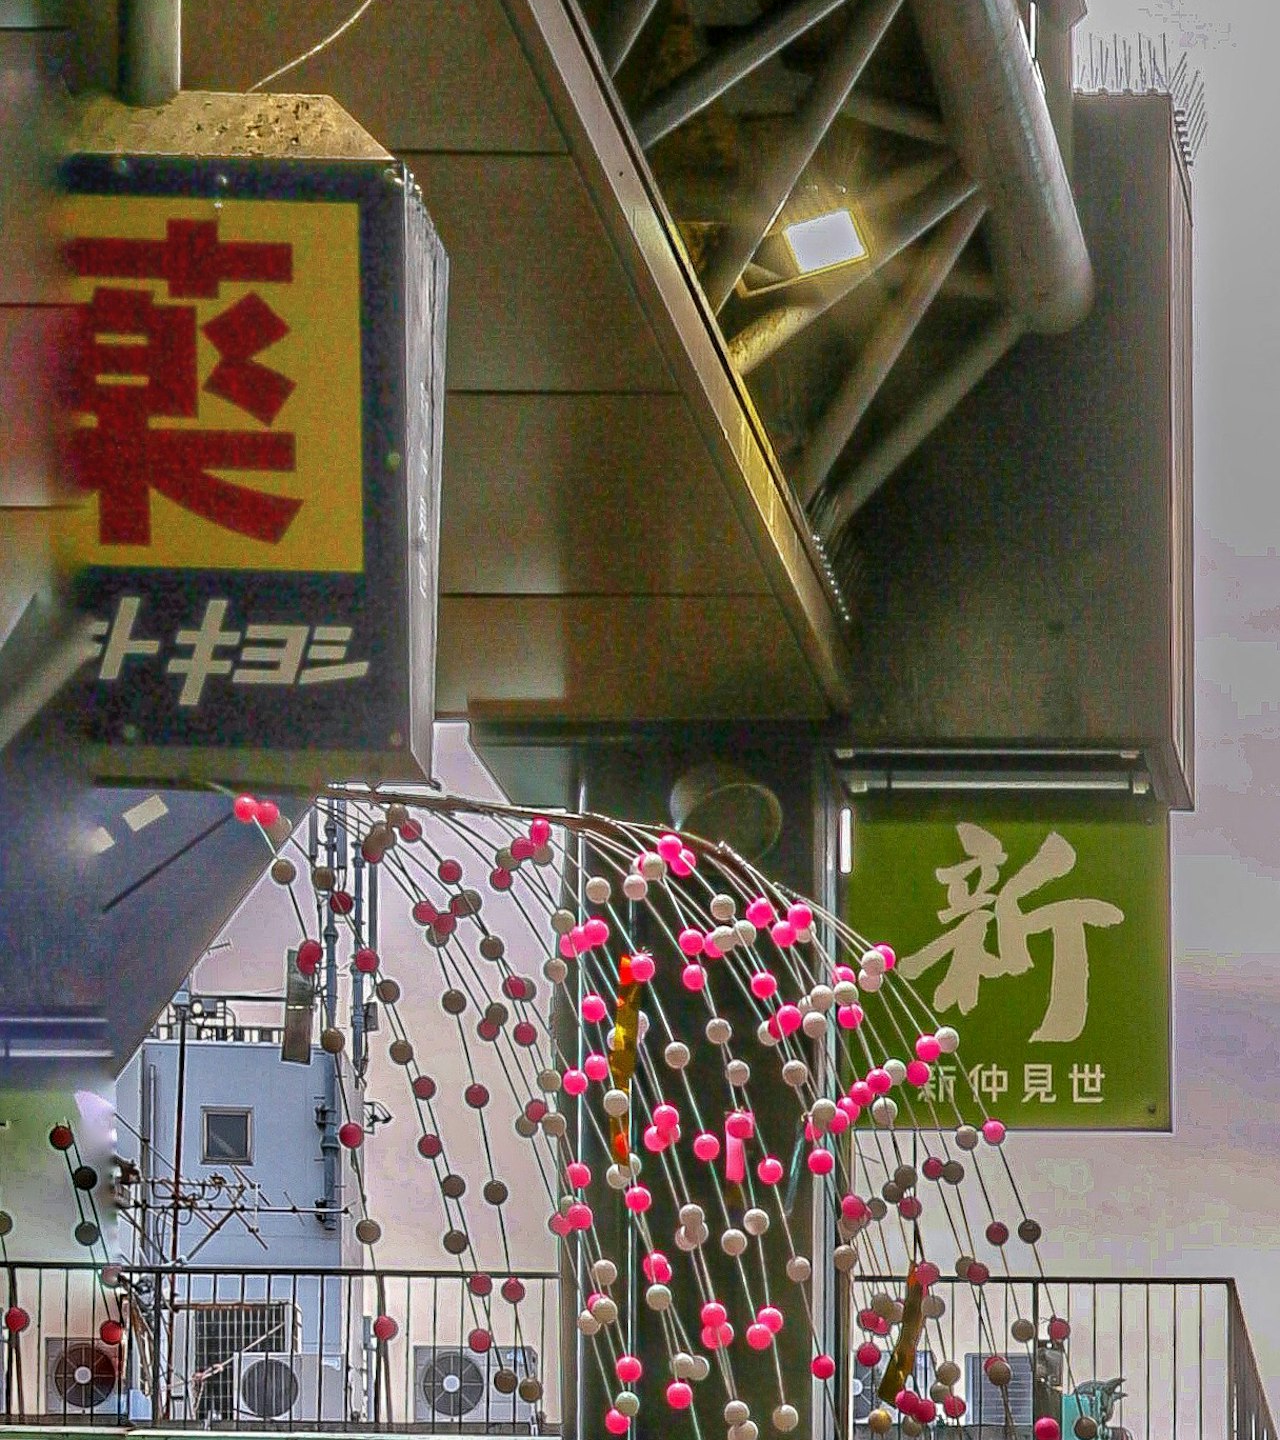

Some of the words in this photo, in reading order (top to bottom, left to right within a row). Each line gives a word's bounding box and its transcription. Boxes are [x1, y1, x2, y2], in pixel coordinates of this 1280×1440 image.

[93, 596, 370, 706] トキヨシ
[902, 821, 1125, 1043] 新
[916, 1063, 1105, 1103] 新仲見世
